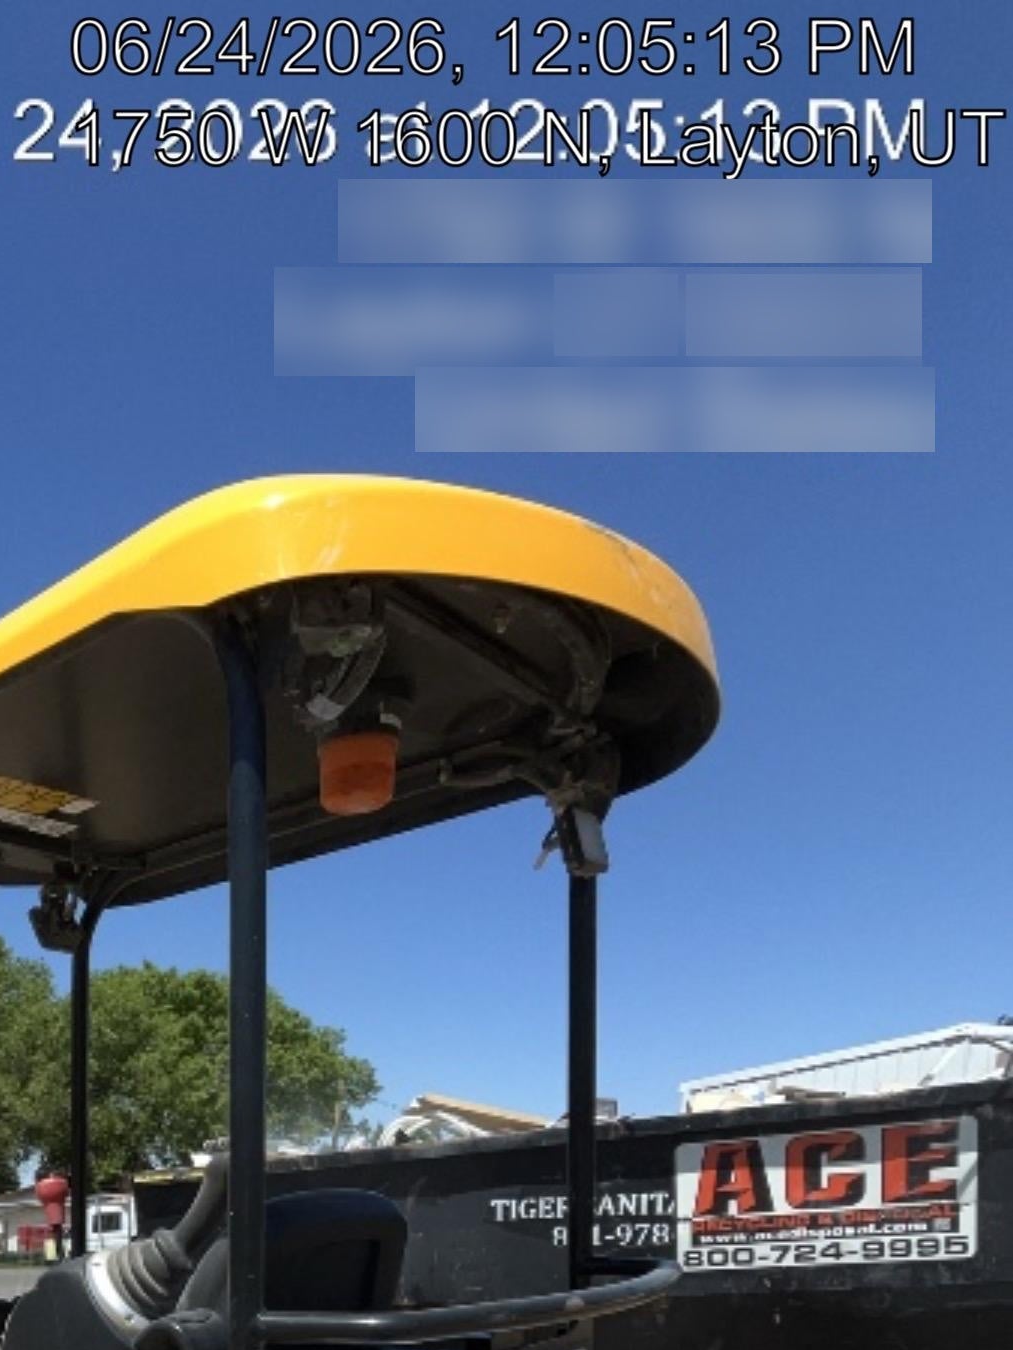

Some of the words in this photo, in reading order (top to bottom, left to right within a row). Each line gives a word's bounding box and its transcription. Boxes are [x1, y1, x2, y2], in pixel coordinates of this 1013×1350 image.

[694, 1119, 961, 1218] ACE
[594, 1191, 676, 1217] ANIT
[683, 1235, 970, 1268] 800-724-9995
